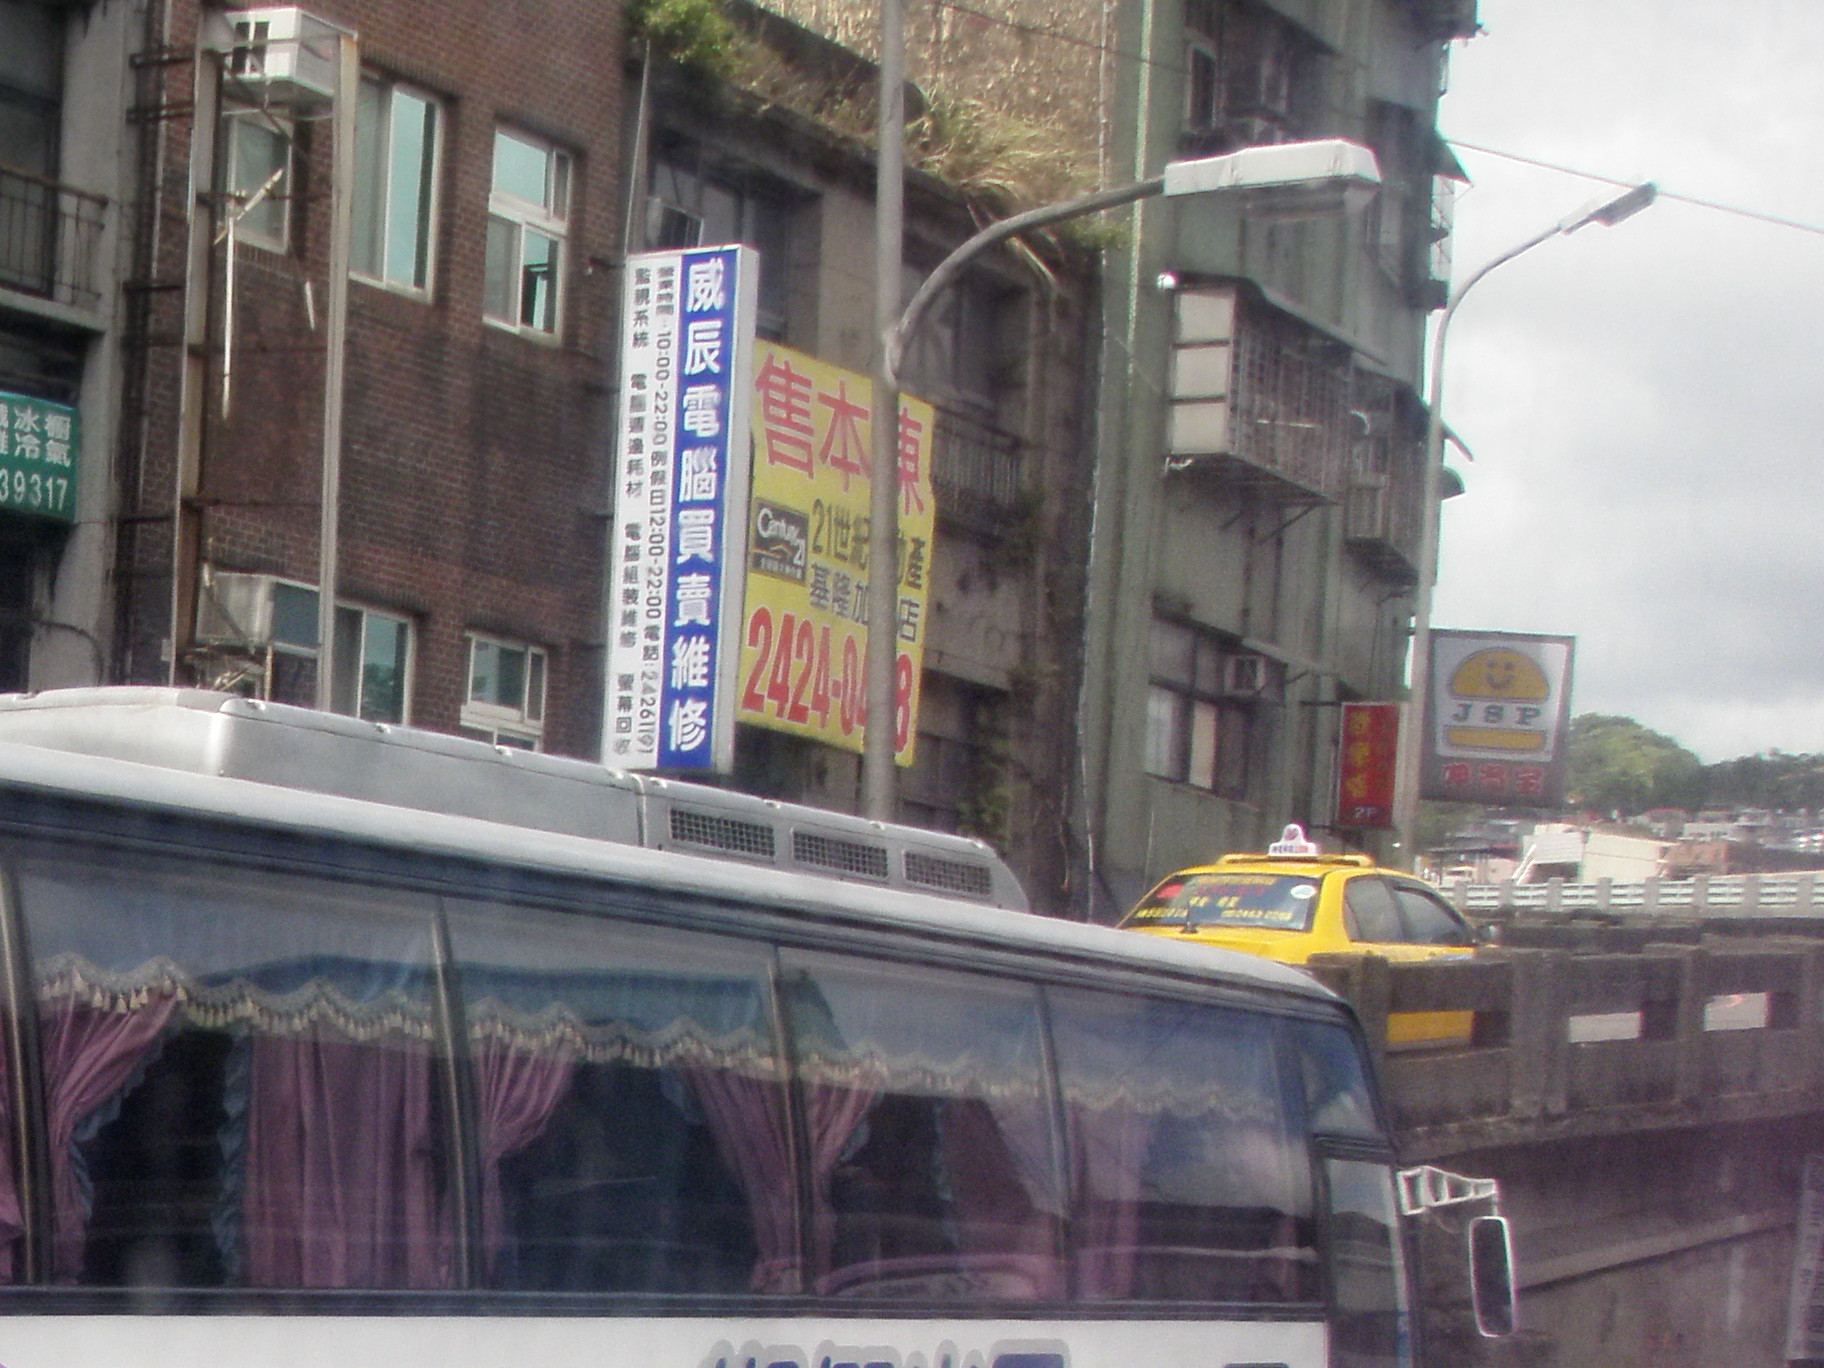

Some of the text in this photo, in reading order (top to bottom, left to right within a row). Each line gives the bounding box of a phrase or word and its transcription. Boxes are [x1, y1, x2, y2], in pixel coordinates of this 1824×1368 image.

[668, 258, 725, 753] 威辰電腦買賣維修
[741, 606, 913, 755] 2424-048
